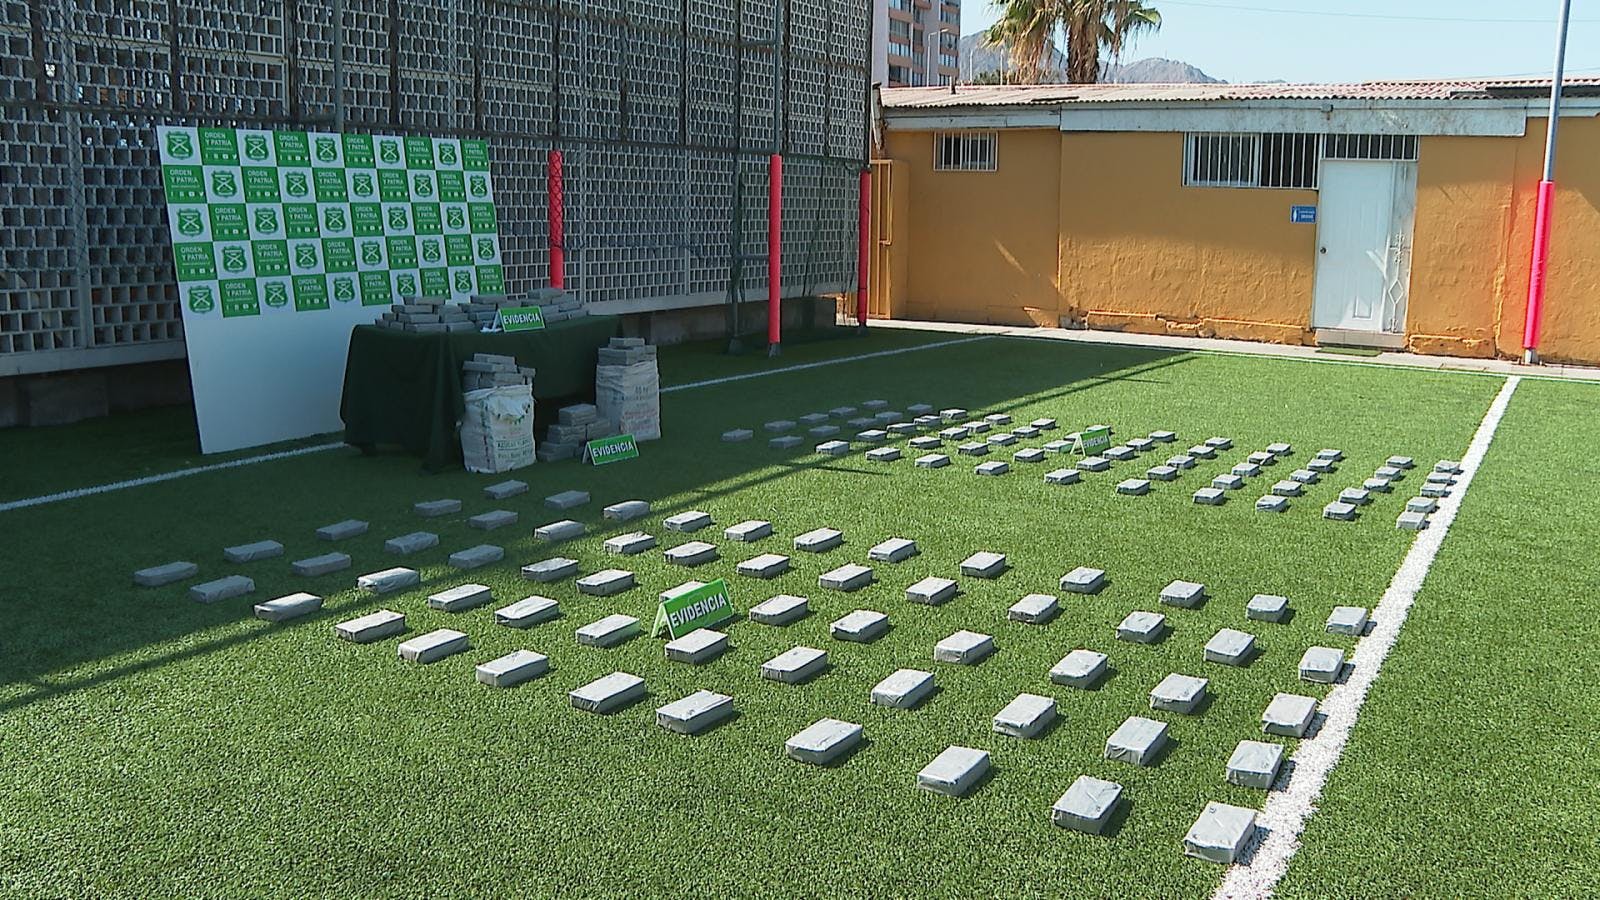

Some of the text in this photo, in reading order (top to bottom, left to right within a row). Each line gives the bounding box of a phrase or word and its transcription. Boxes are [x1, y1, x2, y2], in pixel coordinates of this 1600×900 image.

[503, 312, 540, 325] EVIDENCIA
[592, 441, 634, 458] EVIDENCIA
[670, 592, 726, 628] EVIDENCIA
